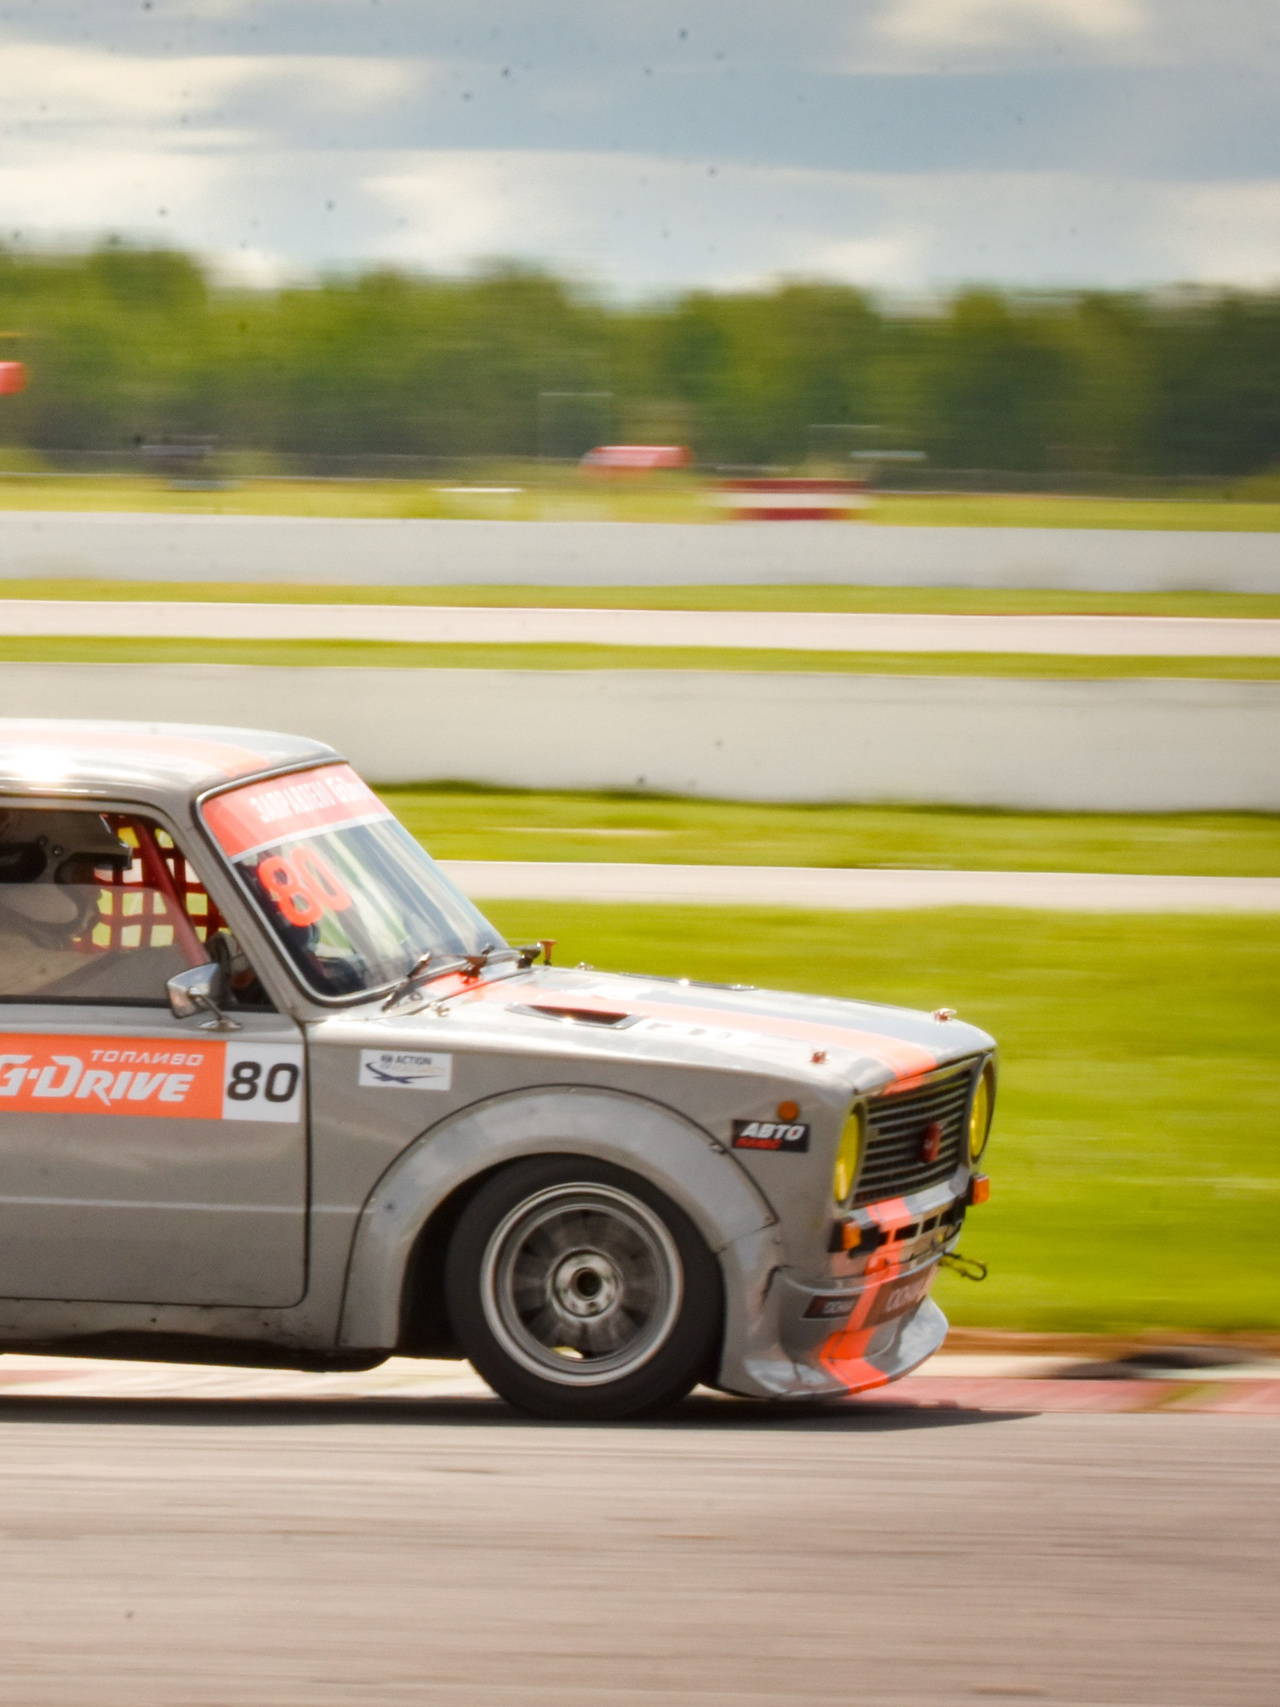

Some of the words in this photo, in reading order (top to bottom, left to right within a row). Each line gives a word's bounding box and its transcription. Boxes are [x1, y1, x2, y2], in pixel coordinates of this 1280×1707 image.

[257, 847, 352, 927] 80
[90, 1049, 204, 1067] ТОПЛИВО
[227, 1061, 299, 1103] 80
